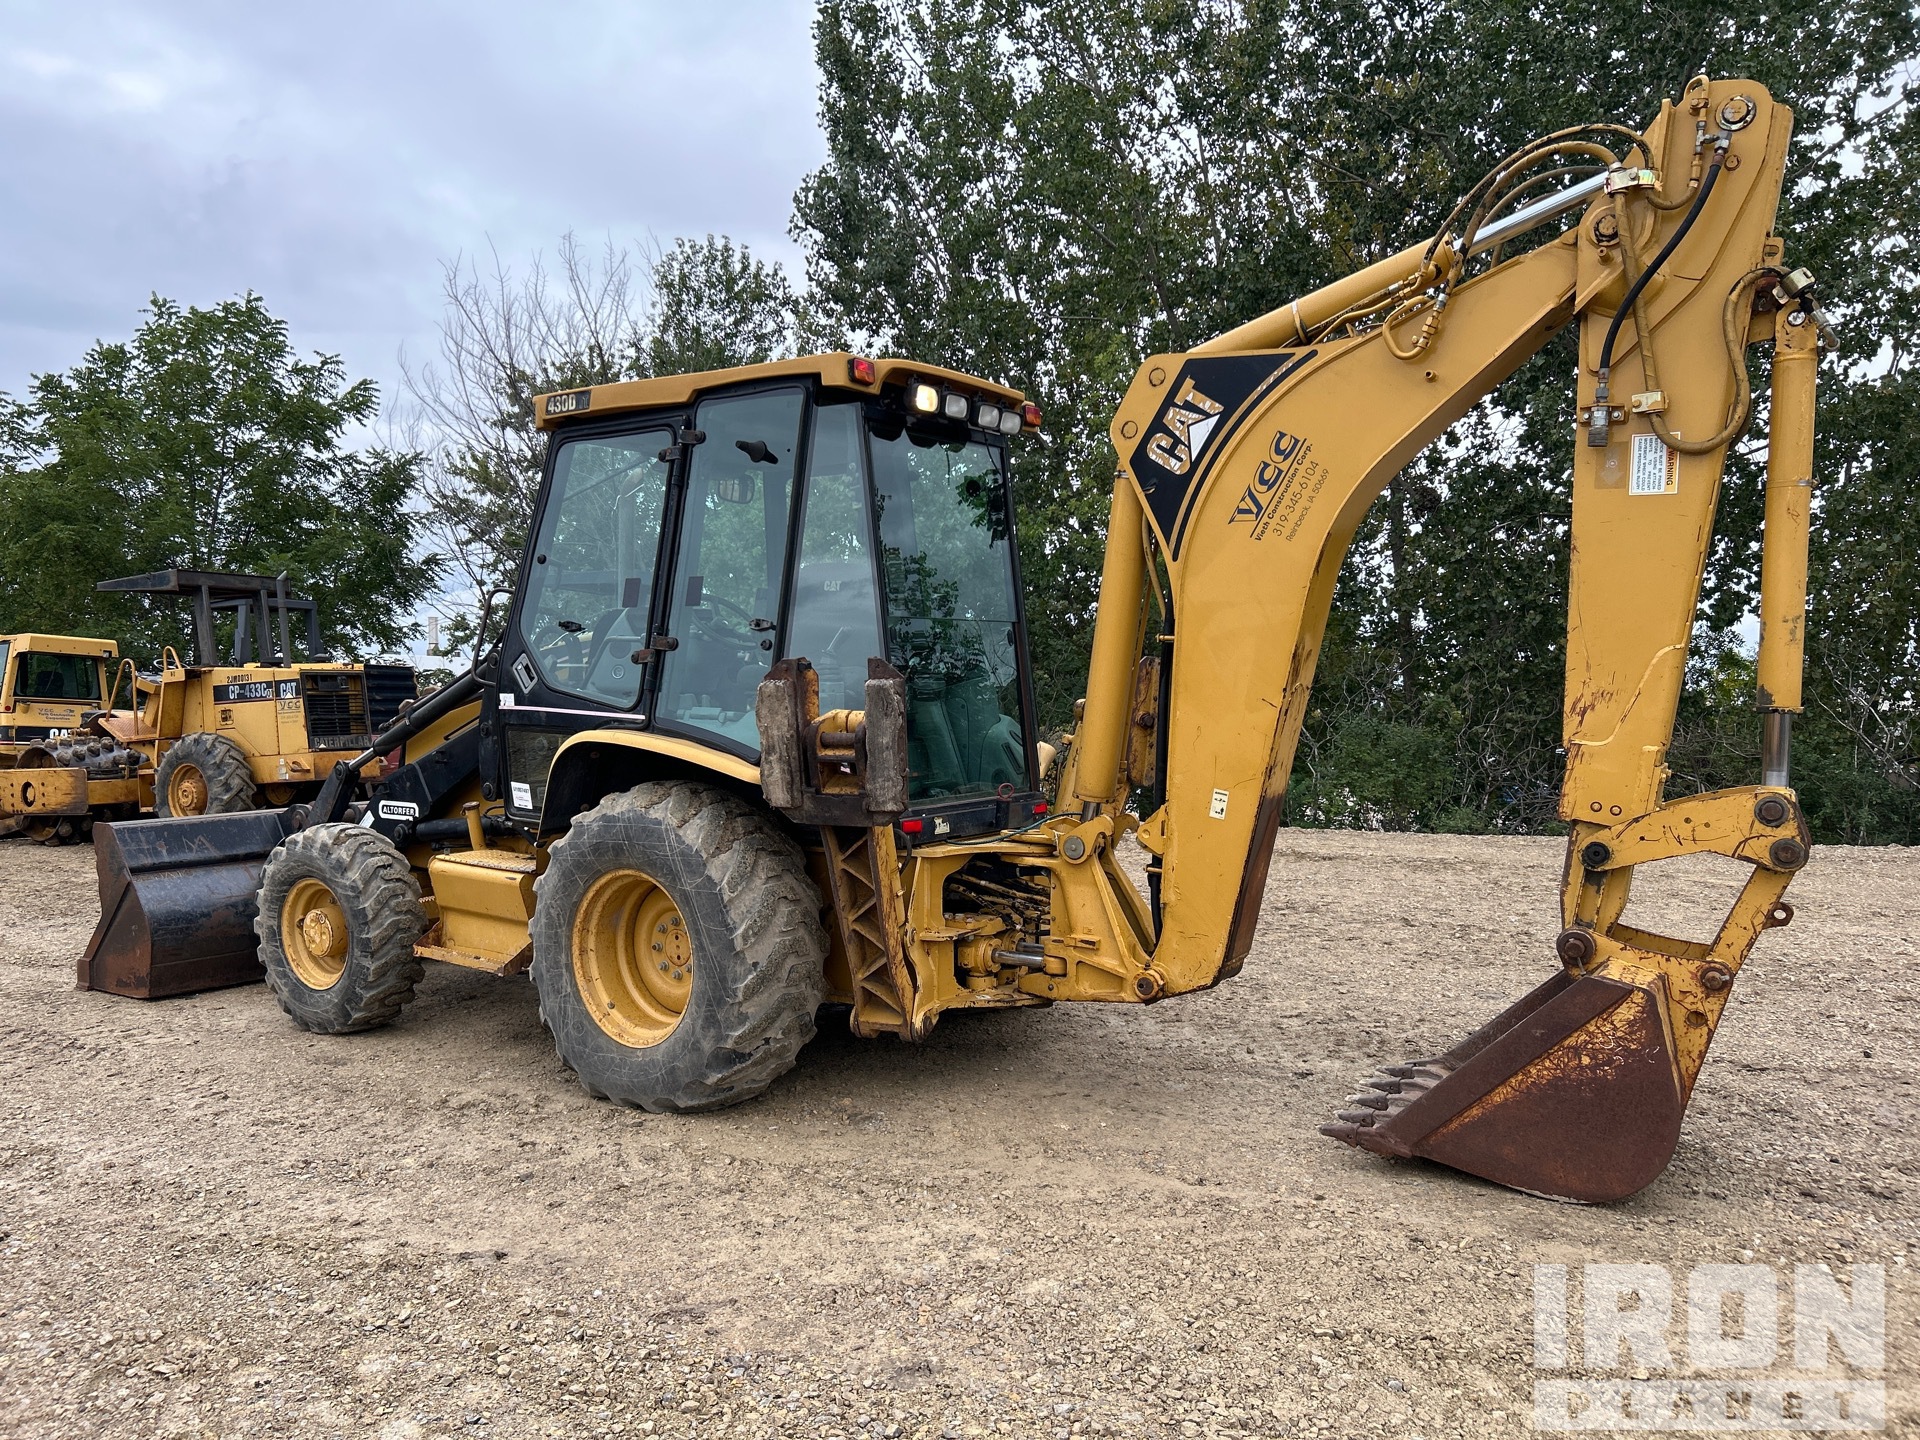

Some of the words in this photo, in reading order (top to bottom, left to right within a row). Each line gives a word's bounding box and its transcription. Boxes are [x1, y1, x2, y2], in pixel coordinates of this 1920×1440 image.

[547, 393, 577, 414] 430D
[1146, 374, 1225, 476] CAT
[1228, 430, 1301, 525] VCC
[1666, 449, 1675, 486] WARNING
[1311, 468, 1330, 495] 50669
[1254, 521, 1271, 542] Vieth
[1266, 467, 1300, 520] Construction
[1296, 443, 1313, 466] Corp.
[1272, 460, 1319, 537] 319-345-6104
[1306, 495, 1317, 504] IA
[823, 580, 842, 592] CAT
[228, 682, 268, 700] CP-433C
[279, 681, 298, 699] CAT
[313, 735, 370, 749] CATERPILLAR
[382, 805, 415, 816] ALTORFER
